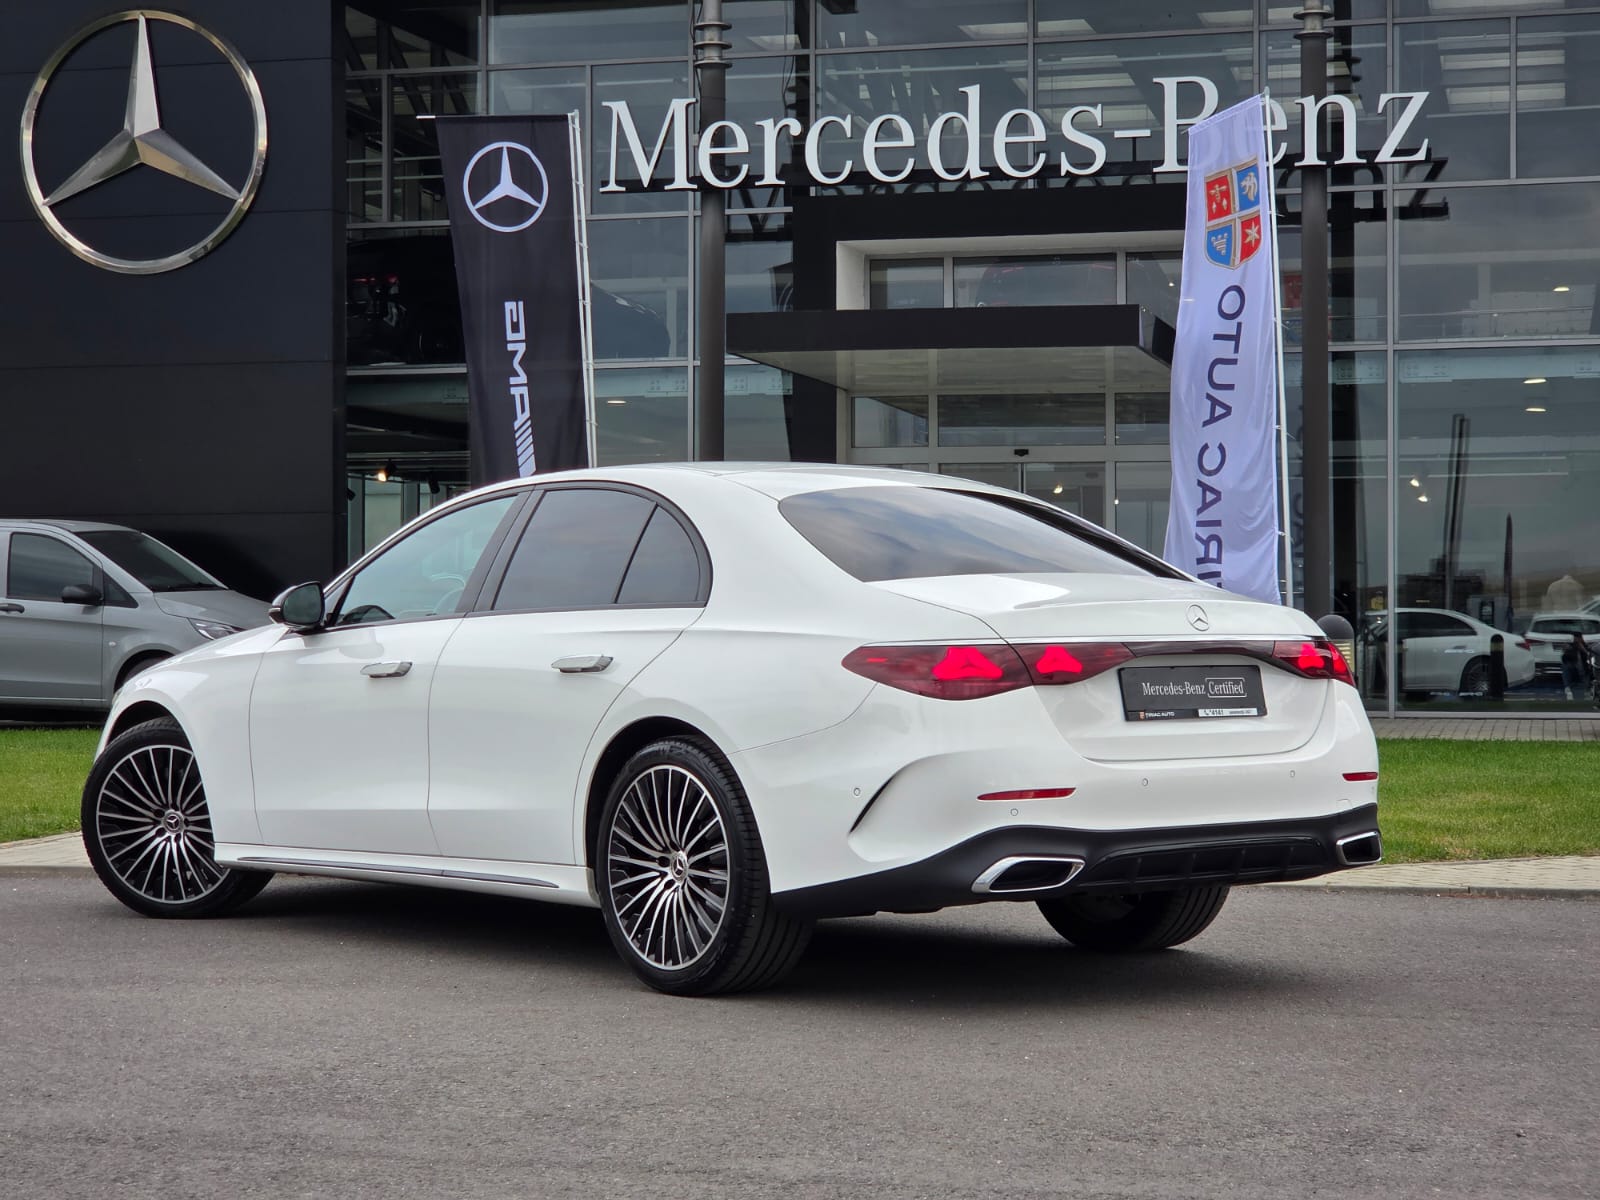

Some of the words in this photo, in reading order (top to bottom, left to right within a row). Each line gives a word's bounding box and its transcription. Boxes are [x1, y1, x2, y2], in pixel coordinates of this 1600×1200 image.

[600, 75, 1429, 193] Mercedes-Benz
[1142, 681, 1206, 696] Mercedes-Benz
[1208, 680, 1244, 695] Certified
